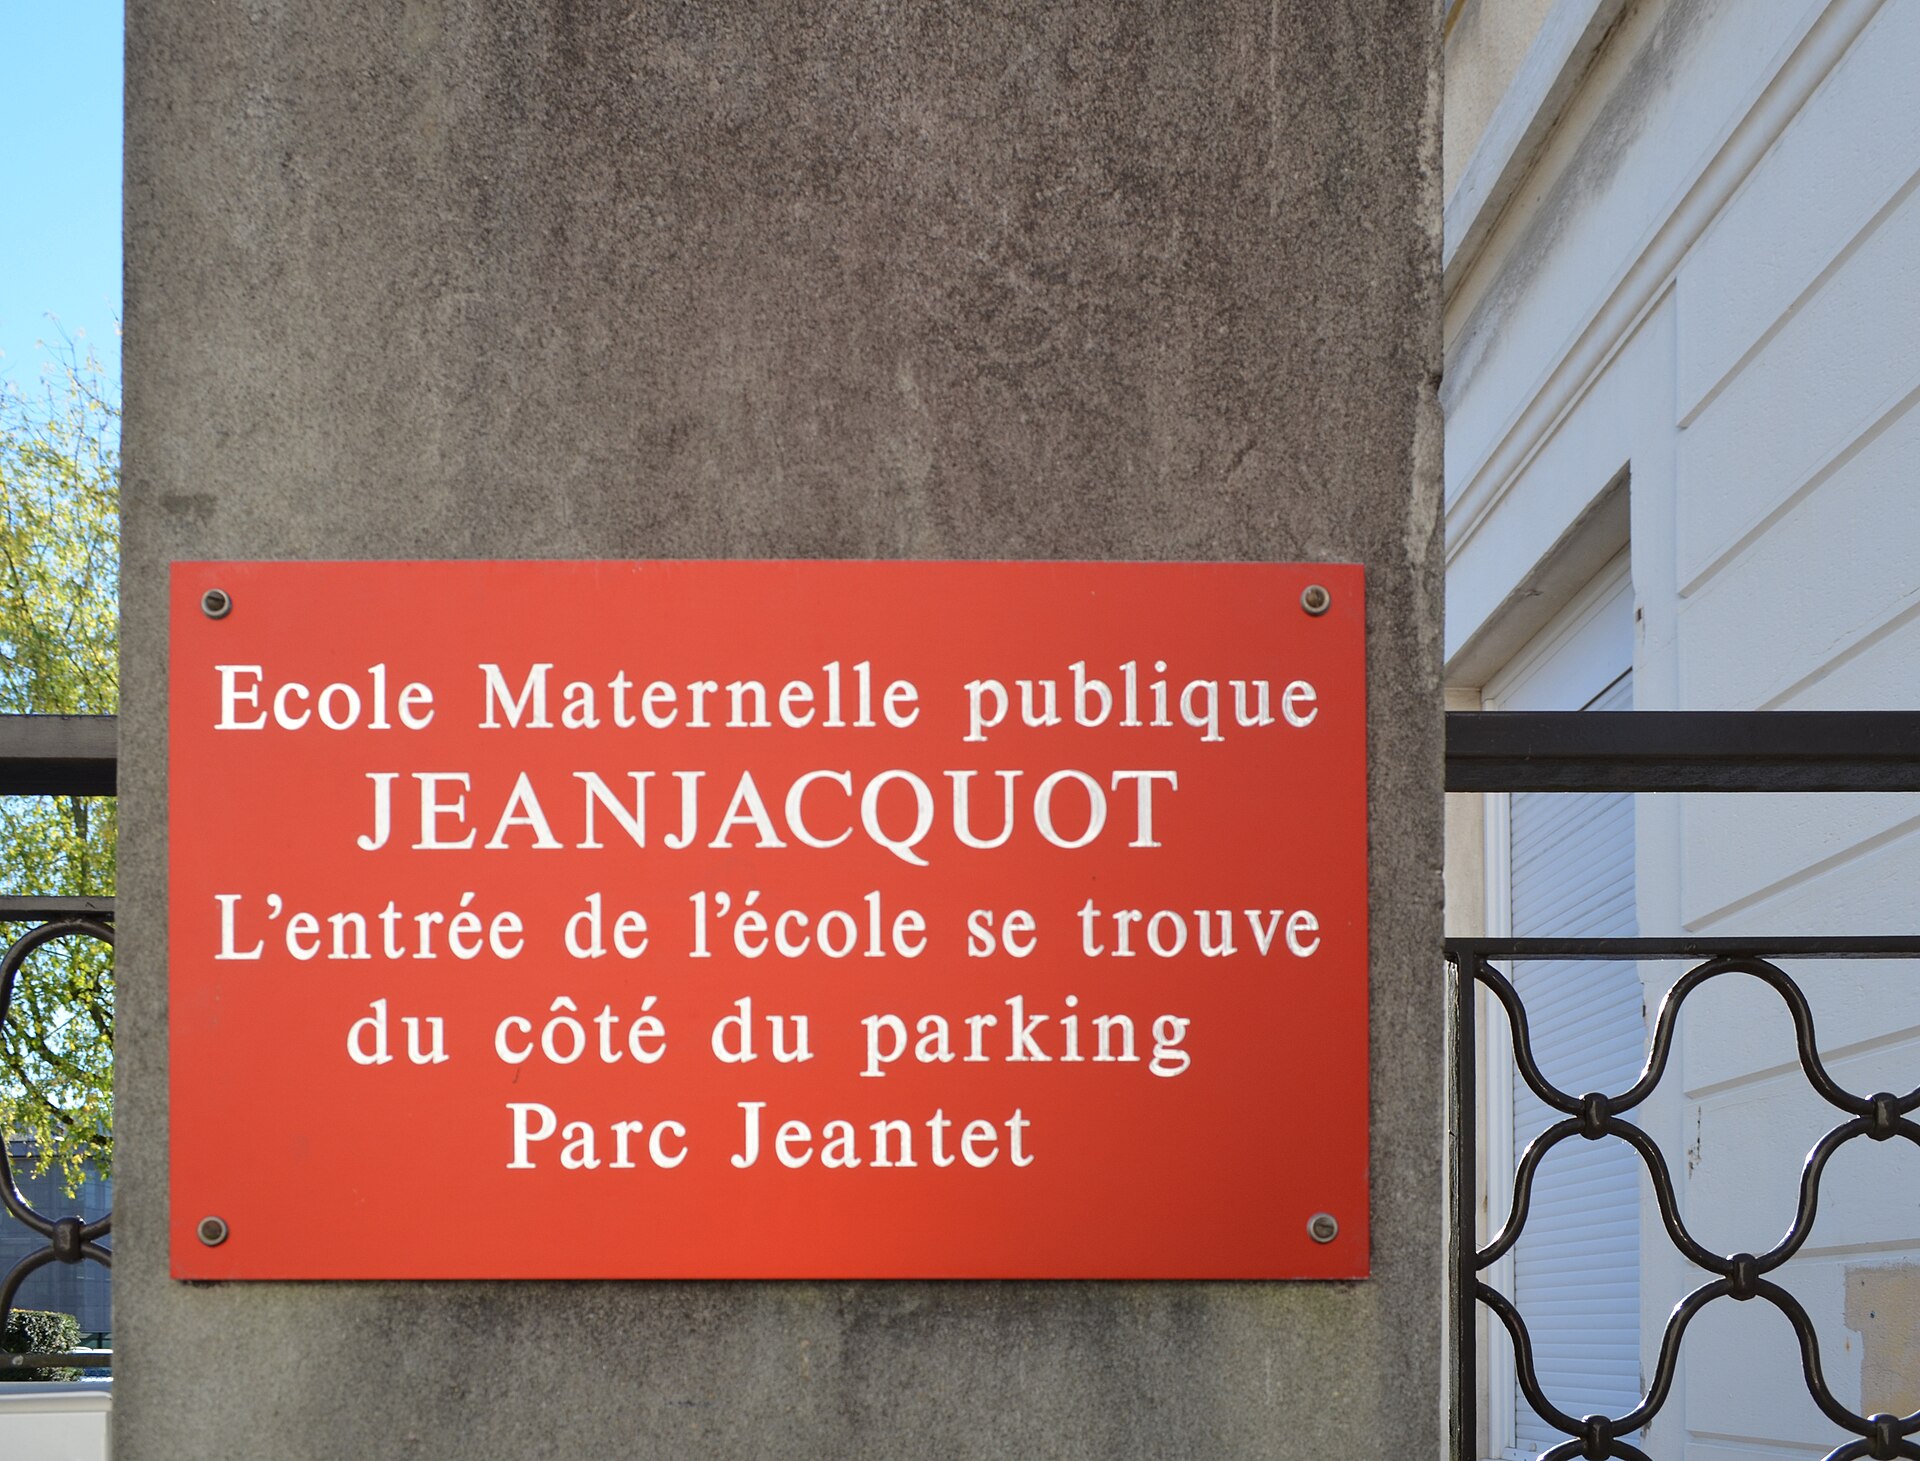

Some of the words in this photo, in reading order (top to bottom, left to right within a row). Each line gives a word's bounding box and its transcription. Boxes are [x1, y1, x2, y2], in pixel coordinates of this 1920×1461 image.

[213, 662, 436, 731] Ecole
[478, 660, 920, 730] Maternelle
[962, 660, 1318, 743] publique
[356, 769, 1178, 867] JEANJACQUOT
[214, 891, 525, 961] L’entrée
[564, 891, 649, 960] de
[688, 890, 928, 959] l’école
[967, 909, 1037, 958] se
[1076, 898, 1321, 959] trouve
[346, 997, 450, 1066] du
[494, 995, 667, 1065] côté
[711, 995, 814, 1064] du
[859, 994, 1191, 1078] parking
[505, 1102, 689, 1170] Parc
[730, 1101, 1035, 1169] Jeantet
